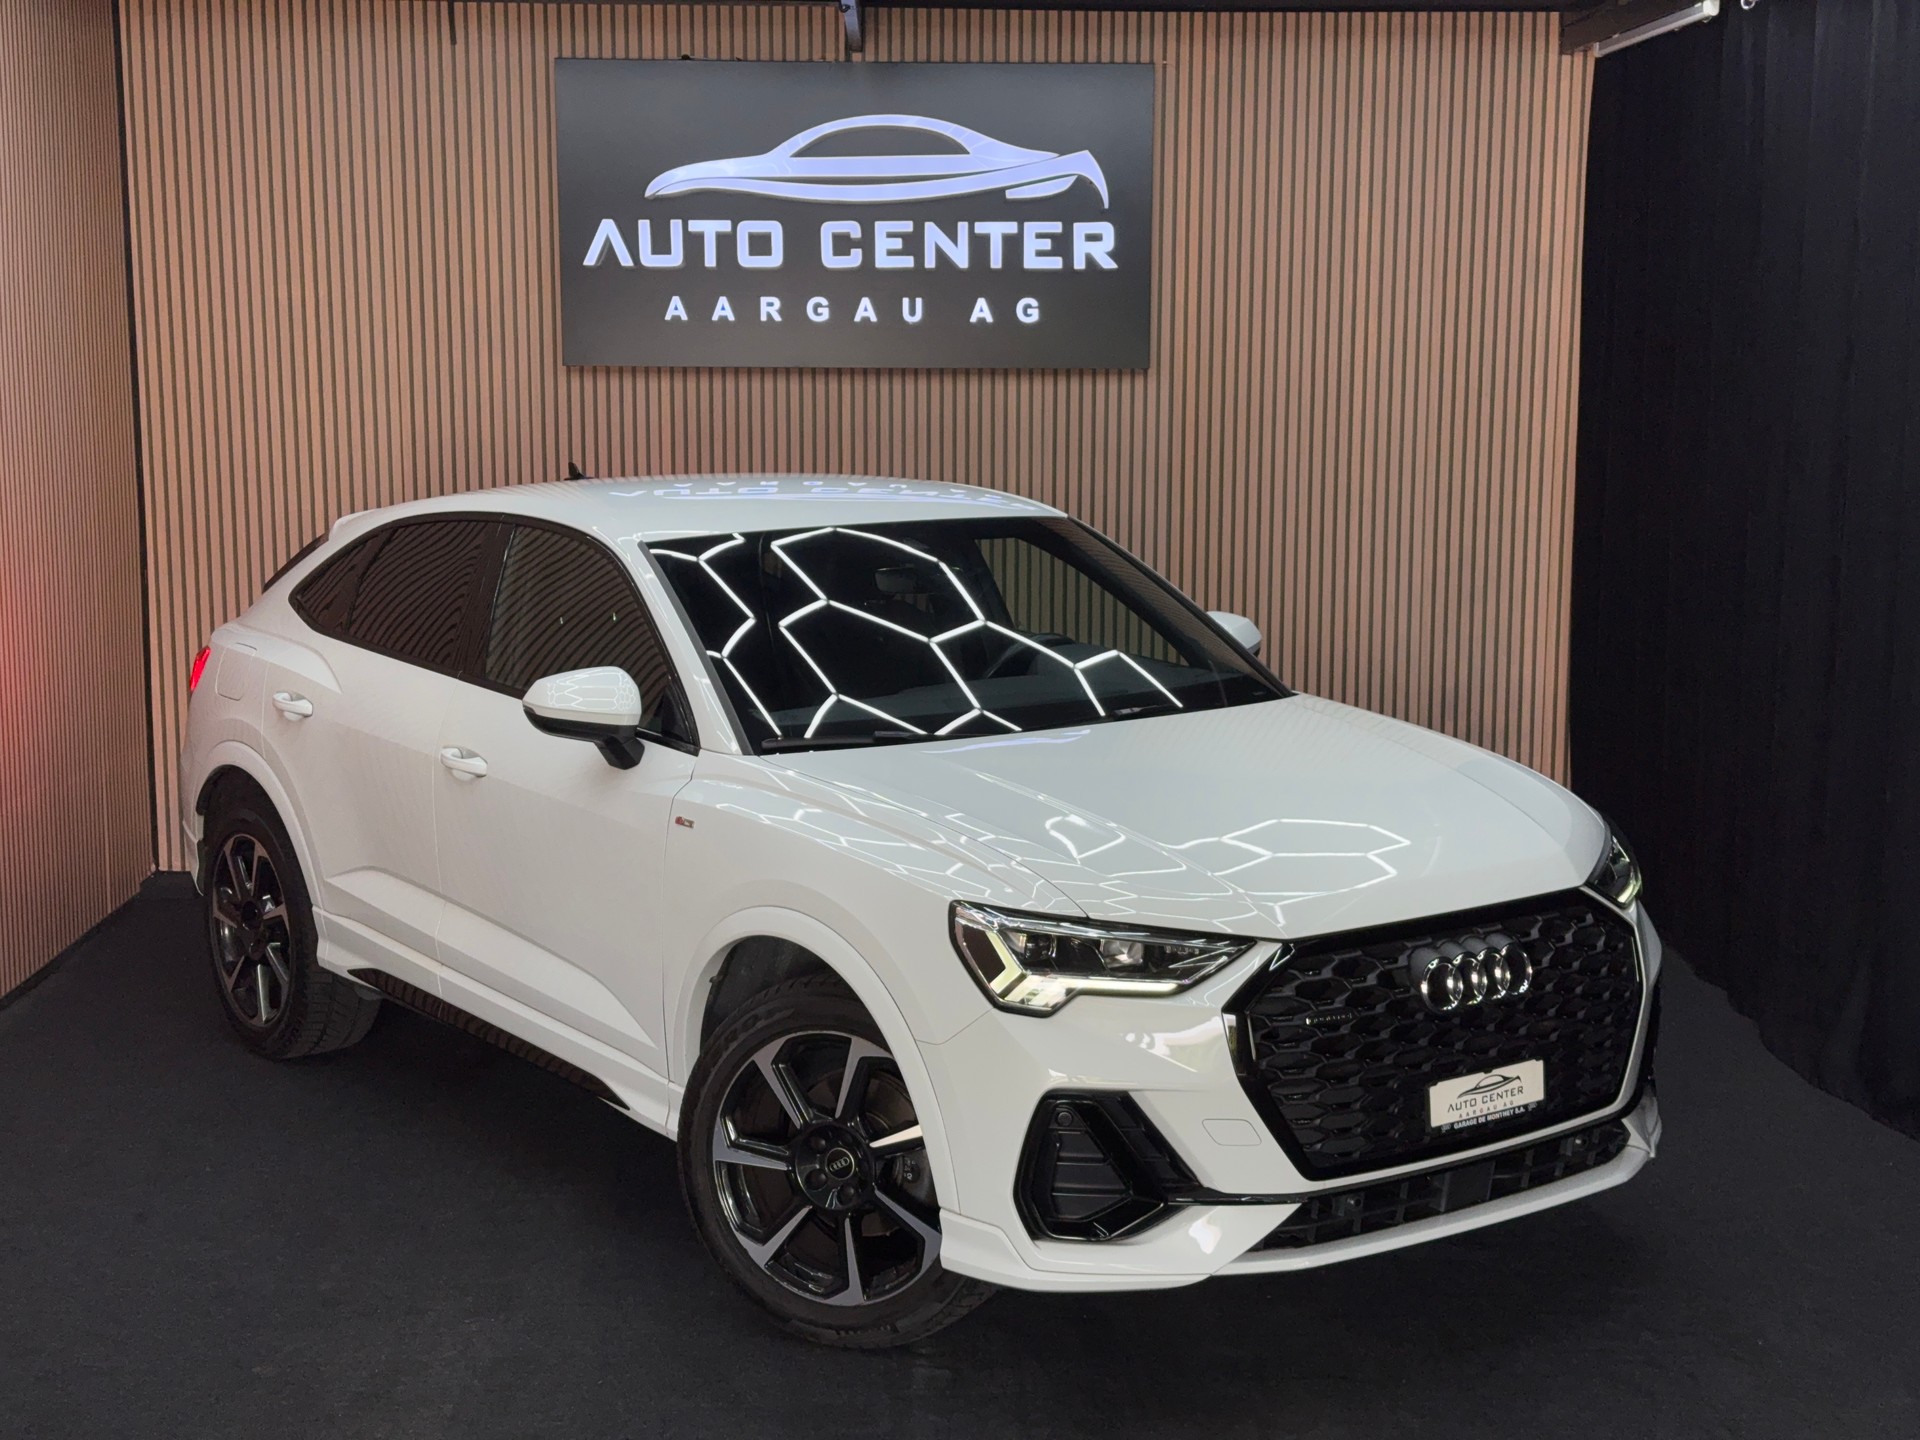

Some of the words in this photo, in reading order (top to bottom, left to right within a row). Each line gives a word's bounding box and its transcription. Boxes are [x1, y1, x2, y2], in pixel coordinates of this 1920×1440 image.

[583, 218, 785, 269] AUTO
[820, 220, 1119, 270] CENTER
[664, 296, 923, 323] AARGAU
[969, 297, 1041, 324] AG
[1447, 1097, 1477, 1113] AUTO
[1481, 1085, 1524, 1104] CENTER
[1453, 1117, 1478, 1129] GARAGE
[1478, 1115, 1486, 1124] DE
